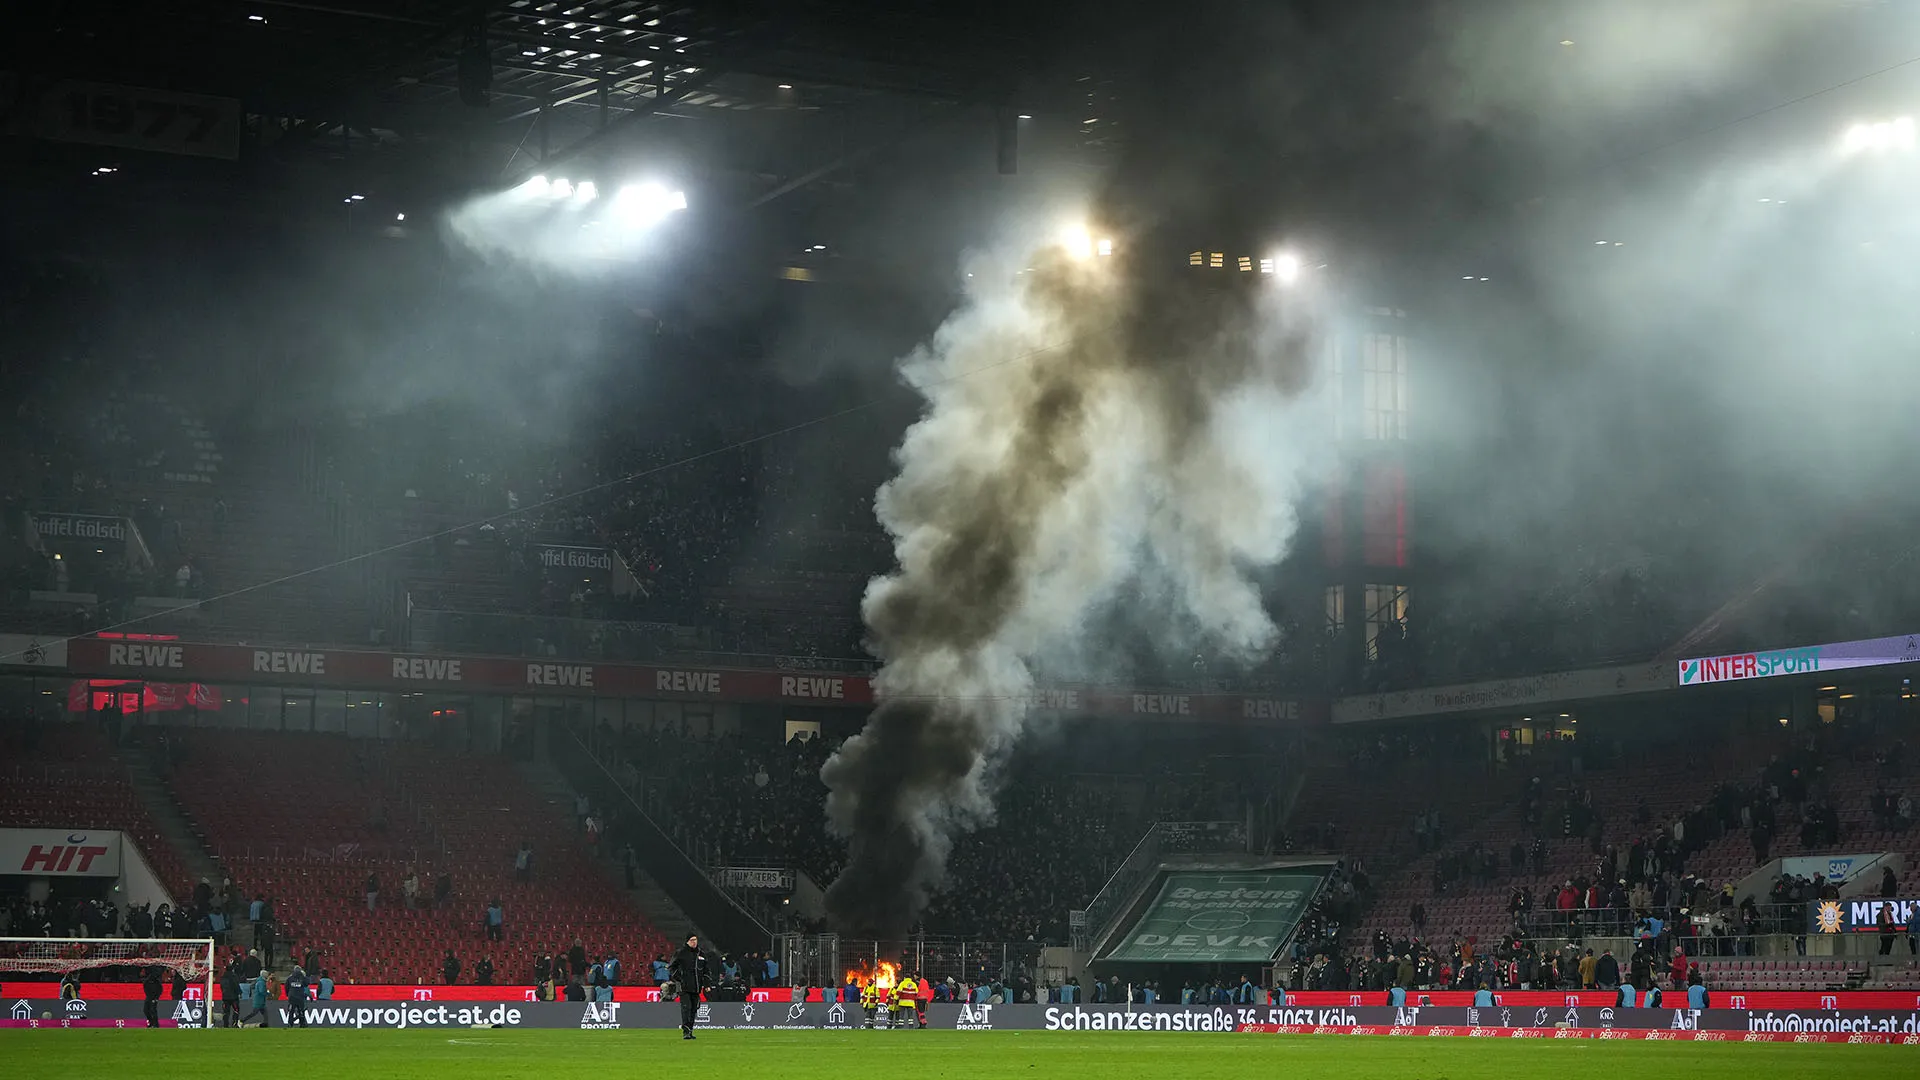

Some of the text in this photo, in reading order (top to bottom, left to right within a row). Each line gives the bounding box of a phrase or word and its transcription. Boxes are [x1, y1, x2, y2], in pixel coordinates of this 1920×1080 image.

[76, 519, 124, 540] Kölsch
[568, 551, 611, 571] Kölsch
[110, 644, 183, 668] REWE
[254, 651, 325, 674] REWE
[393, 658, 462, 681] REWE
[1701, 647, 1822, 682] INTERSPORT
[527, 664, 594, 686] REWE
[656, 671, 720, 693] REWE
[781, 676, 844, 699] REWE
[1133, 694, 1191, 715] REWE
[1243, 700, 1298, 719] REWE
[21, 845, 107, 872] HIT
[1829, 862, 1848, 875] SAP
[1171, 888, 1303, 899] Bestens
[1133, 934, 1279, 947] DEVK
[66, 1000, 87, 1011] KNX
[1045, 1006, 1357, 1031] Schanzenstraße 36 51063 Köln
[1600, 1007, 1614, 1020] KNX
[1351, 1026, 1375, 1035] DERTOUR
[1389, 1026, 1415, 1036] DERTOUR
[1428, 1026, 1455, 1036] DERTOUR
[1469, 1027, 1497, 1037] DERTOUR
[1511, 1028, 1540, 1038] DERTOUR
[1554, 1028, 1583, 1039] DERTOUR
[1599, 1029, 1628, 1039] DERTOUR
[1645, 1030, 1676, 1041] DERTOUR
[1694, 1030, 1726, 1041] DERTOUR
[1744, 1031, 1774, 1042] DERTOUR
[1794, 1032, 1827, 1043] DERTOUR
[1848, 1033, 1881, 1044] DERTOUR
